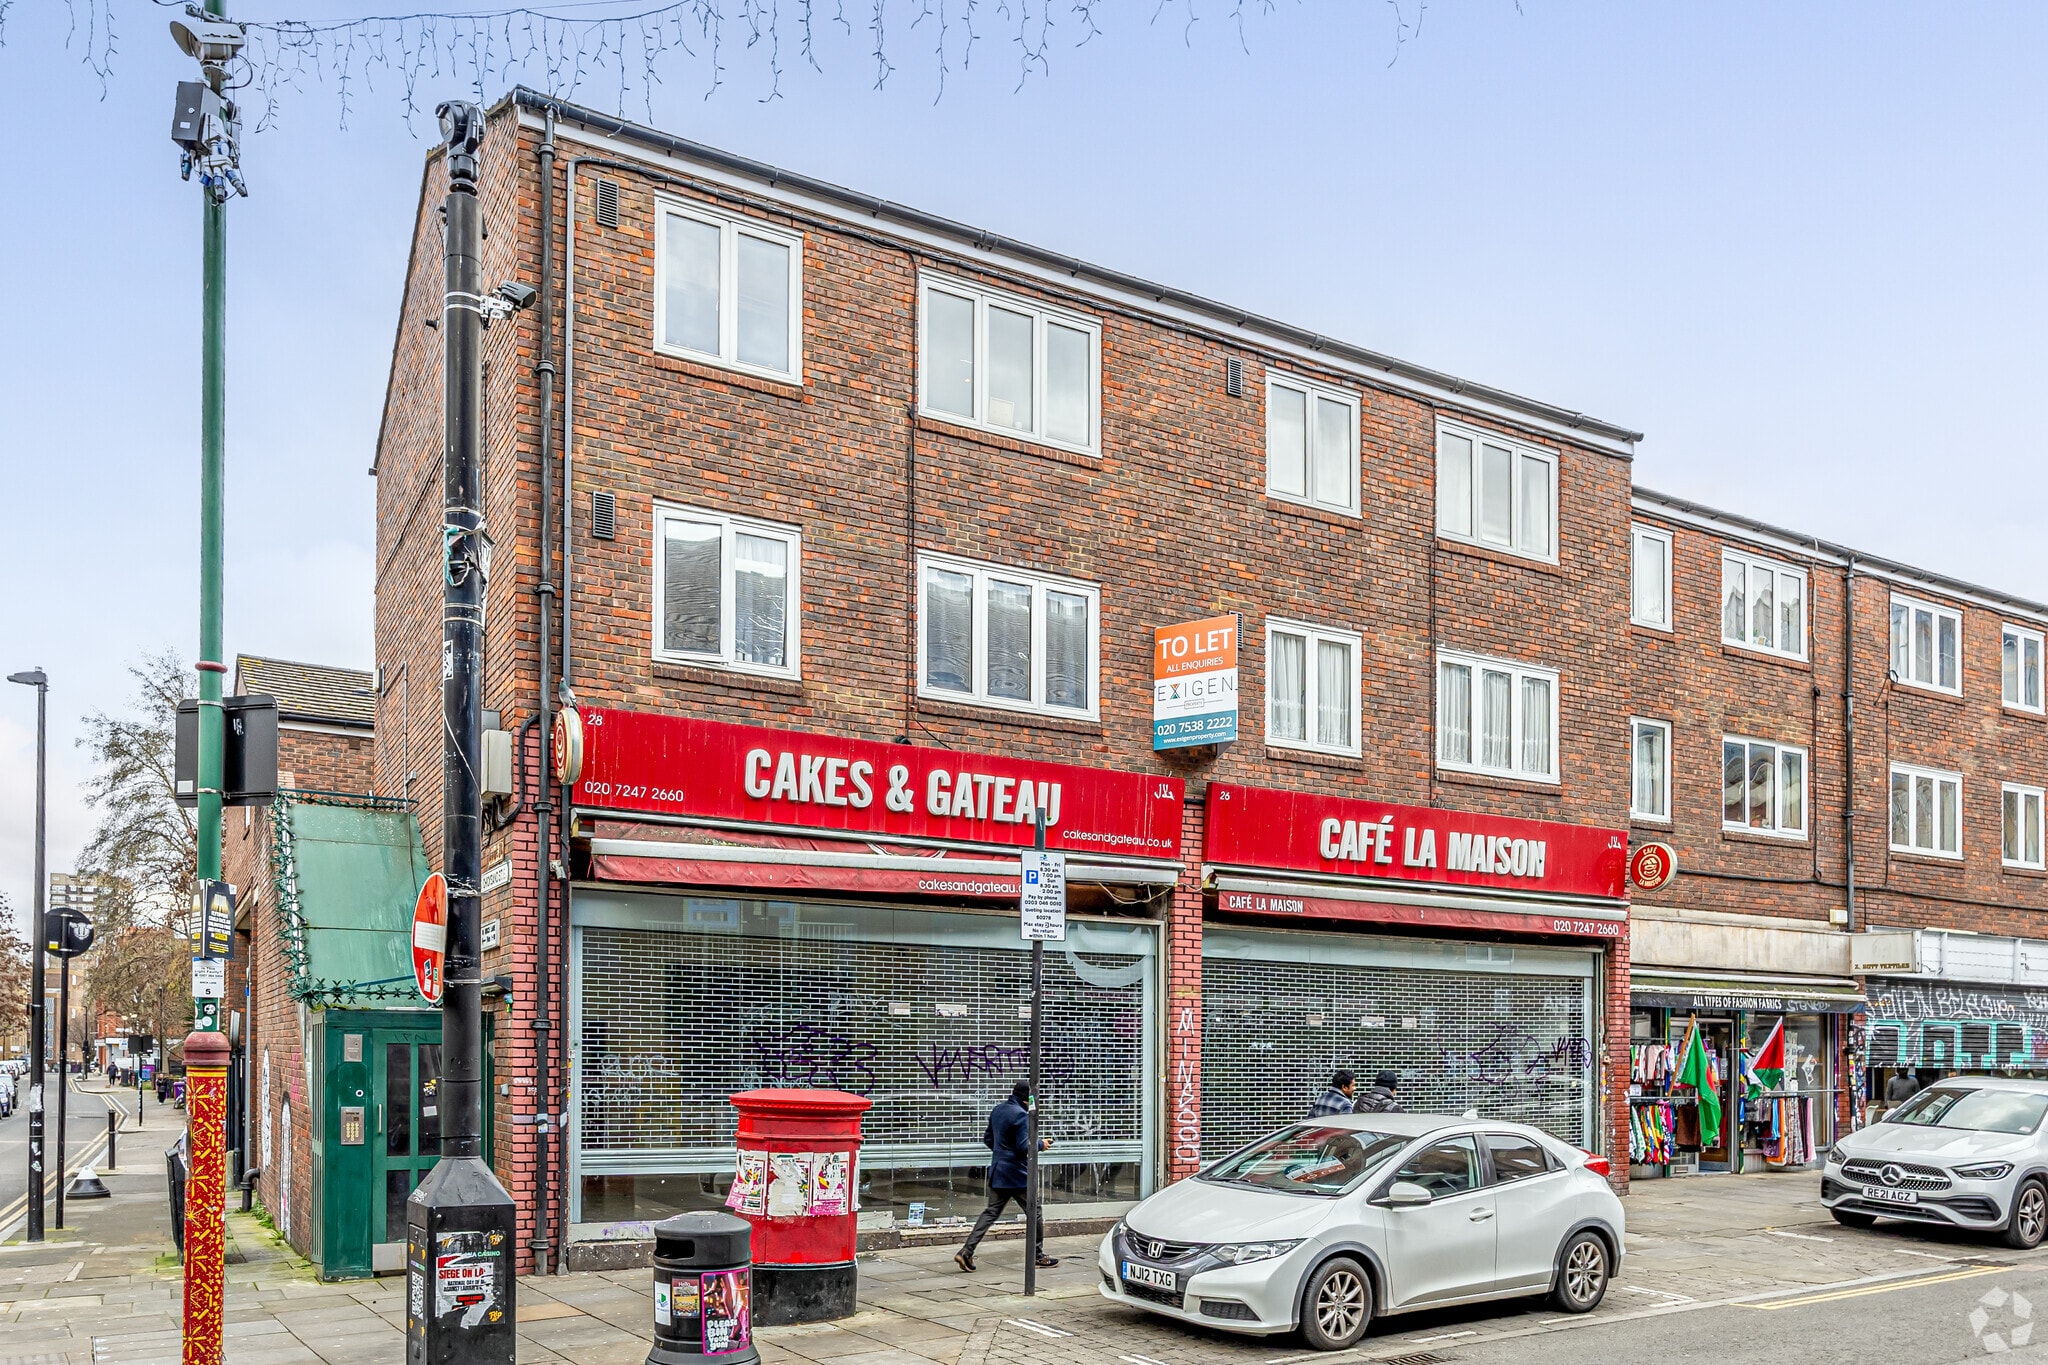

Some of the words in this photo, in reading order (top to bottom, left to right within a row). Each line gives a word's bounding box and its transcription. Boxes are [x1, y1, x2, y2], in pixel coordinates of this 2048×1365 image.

[1158, 635, 1189, 660] TO
[1194, 627, 1233, 655] LET
[1166, 662, 1181, 673] ALL
[1181, 656, 1224, 671] ENQUIRIES
[1157, 675, 1234, 702] EXIGEN
[587, 714, 603, 726] 28
[1157, 723, 1176, 736] 020
[1178, 720, 1204, 734] 7538
[1206, 716, 1233, 730] 2222
[1163, 730, 1227, 744] www.exigenproperty.com
[584, 780, 611, 795] 020
[615, 783, 647, 799] 7247
[651, 787, 684, 802] 2660
[744, 748, 874, 809] CAKES
[885, 764, 914, 813] &
[926, 768, 1062, 827] GATEAU
[1154, 783, 1175, 801] حلال
[1219, 791, 1231, 801] 26
[1062, 829, 1173, 849] cakesandgateau.co.uk
[1319, 815, 1394, 864] CAFÉ
[1403, 827, 1437, 868] LA
[1447, 831, 1547, 878] MAISON
[1607, 835, 1622, 850] حلال
[1028, 871, 1037, 883] P
[1229, 894, 1252, 910] CAFÉ
[1256, 897, 1267, 911] LA
[1270, 898, 1304, 913] MAISON
[1553, 919, 1571, 932] 020
[1573, 921, 1595, 934] 7247
[1597, 923, 1619, 936] 2660
[1693, 995, 1704, 1007] ALL
[1704, 996, 1722, 1008] TYPES
[1722, 996, 1732, 1008] OF
[1732, 996, 1758, 1009] FASHION
[1758, 998, 1782, 1010] FABRICS
[1867, 1188, 1889, 1199] RE21
[1891, 1191, 1911, 1201] AGZ
[438, 1268, 461, 1280] SIEGE
[462, 1268, 472, 1278] ON
[1130, 1265, 1150, 1281] NJ12
[1153, 1270, 1172, 1286] TXG
[706, 1319, 738, 1329] PLEASE
[707, 1326, 728, 1338] BIN
